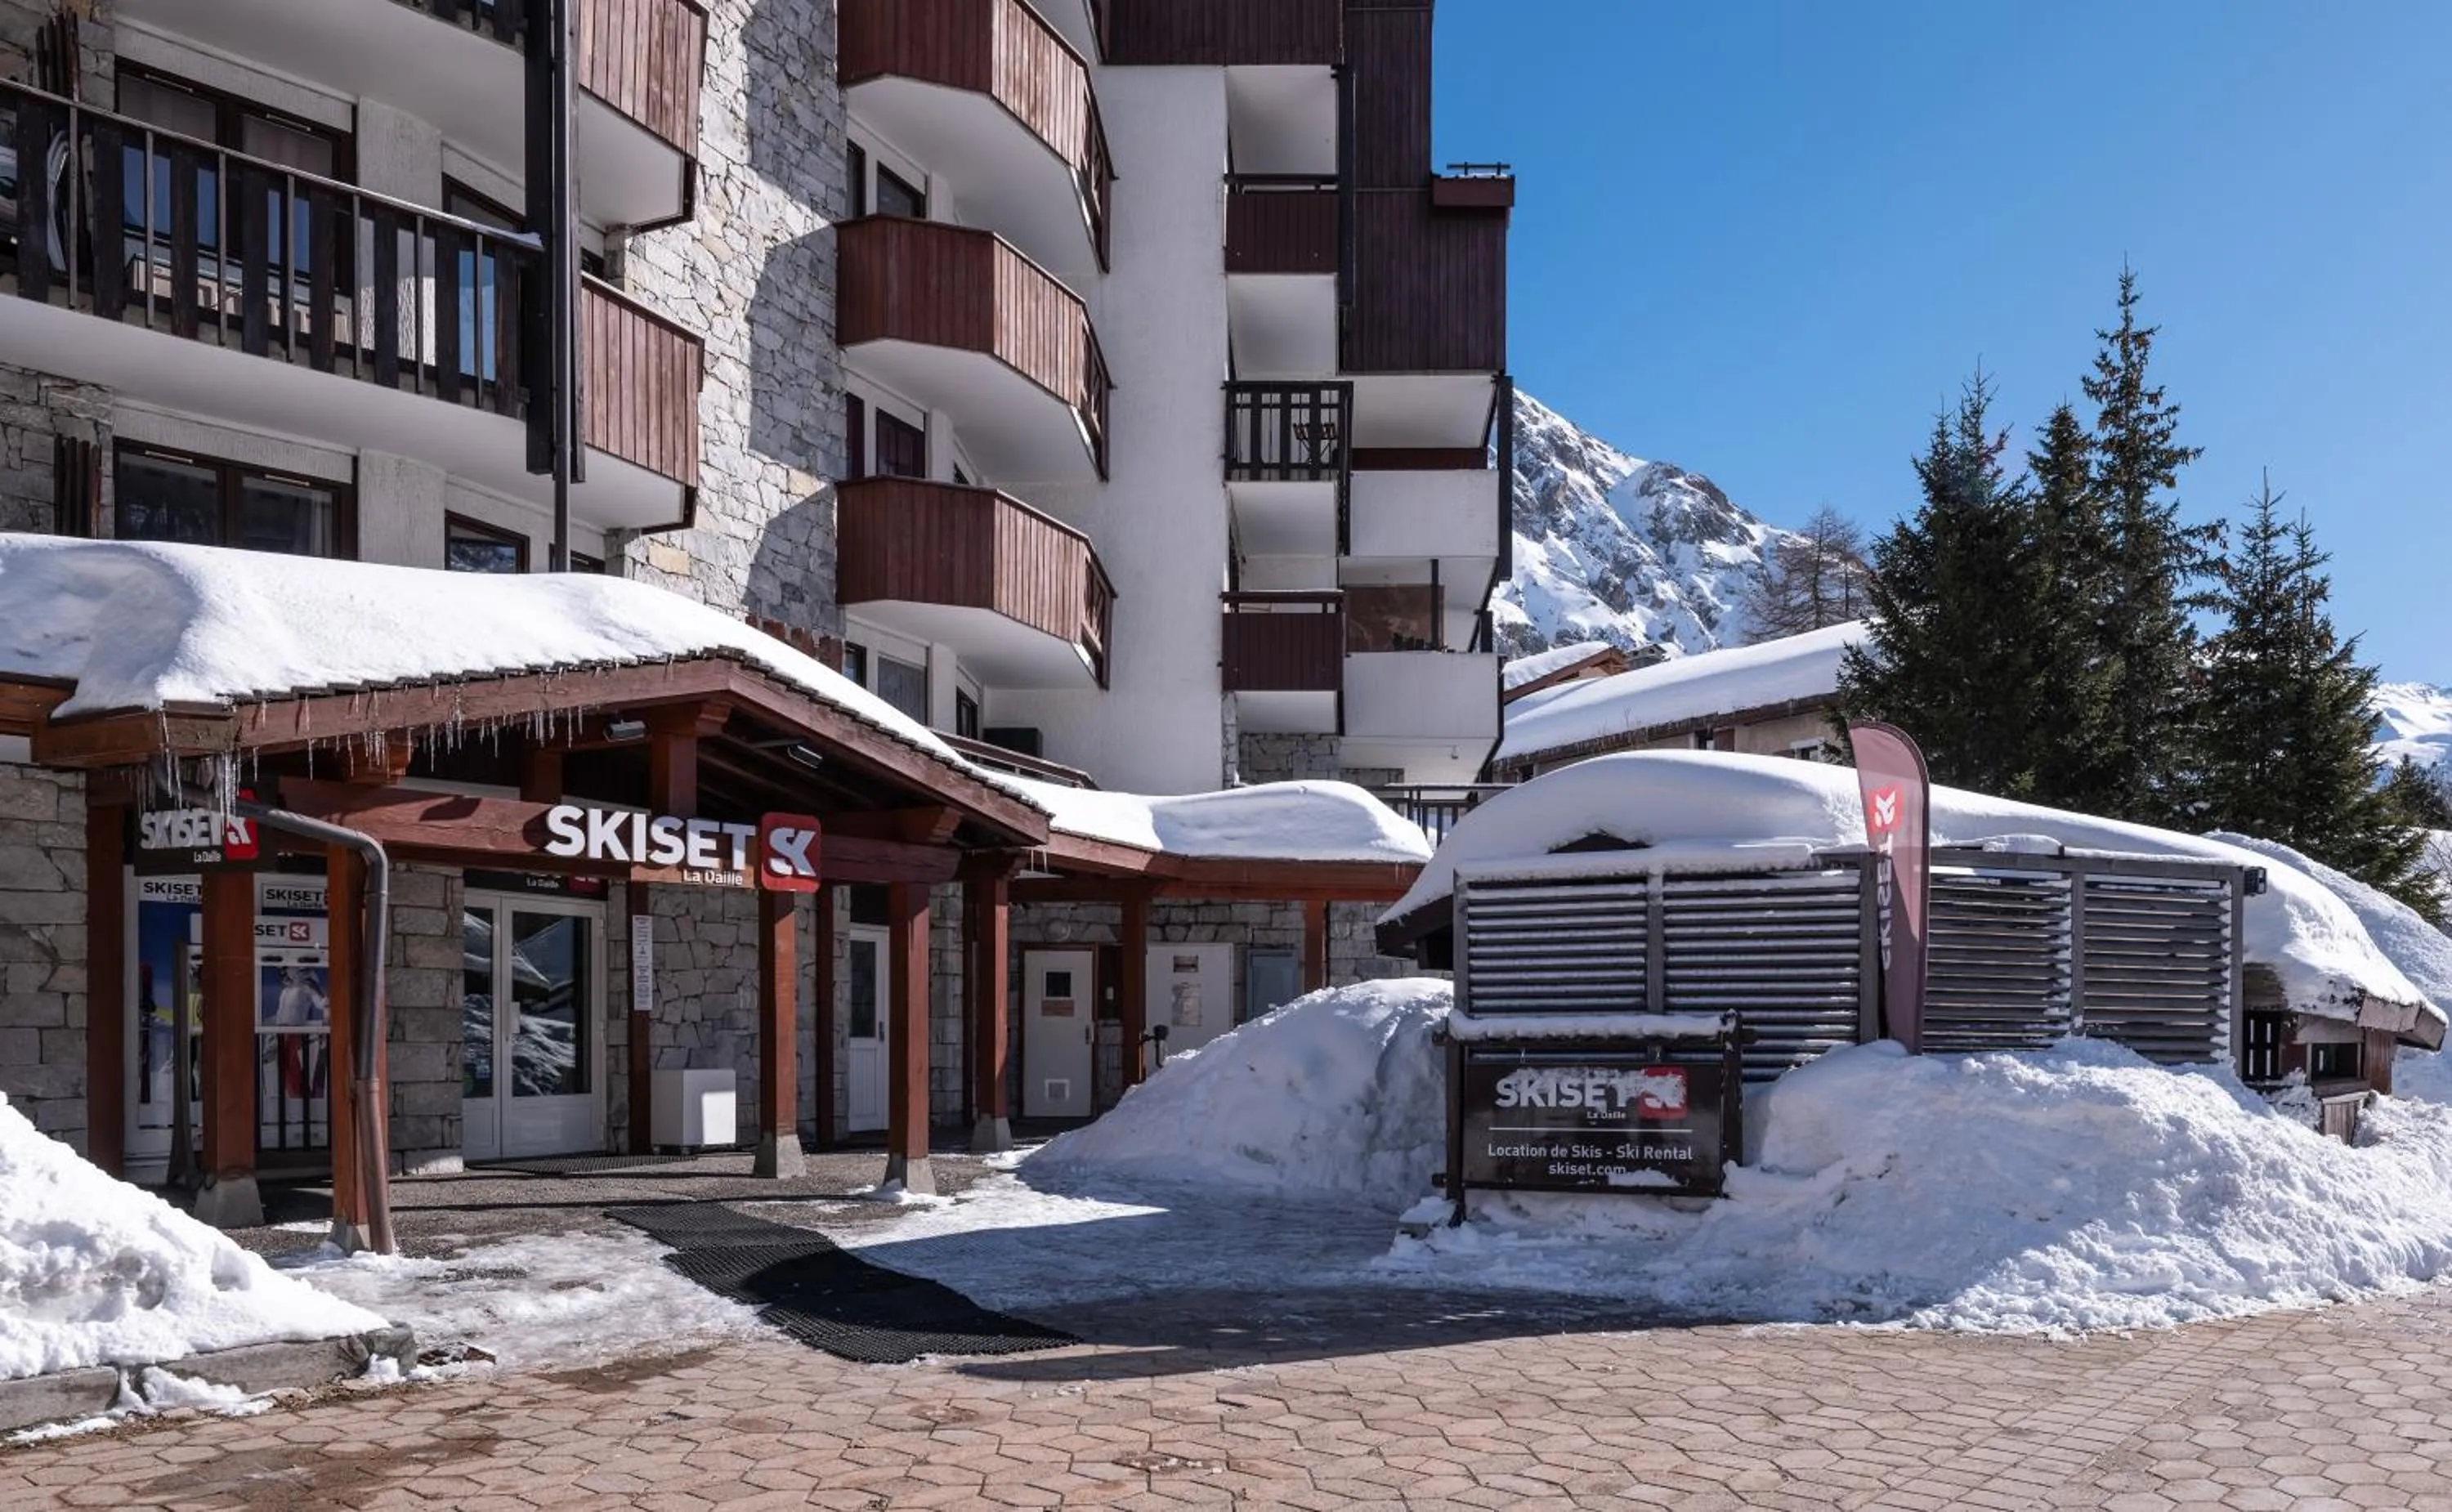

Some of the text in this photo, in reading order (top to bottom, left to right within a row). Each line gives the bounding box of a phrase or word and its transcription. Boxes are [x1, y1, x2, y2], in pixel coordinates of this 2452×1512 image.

[141, 807, 222, 849] SKISET
[545, 805, 756, 870] SKISET
[684, 870, 743, 886] La Daille
[266, 888, 321, 901] SKISET
[1495, 1068, 1631, 1107] SKISET
[1488, 1143, 1547, 1157] Location
[1550, 1145, 1568, 1157] de
[1572, 1146, 1602, 1158] Skis
[1616, 1144, 1639, 1159] Ski
[1644, 1147, 1694, 1161] Rental
[1549, 1161, 1627, 1176] skiset.com
